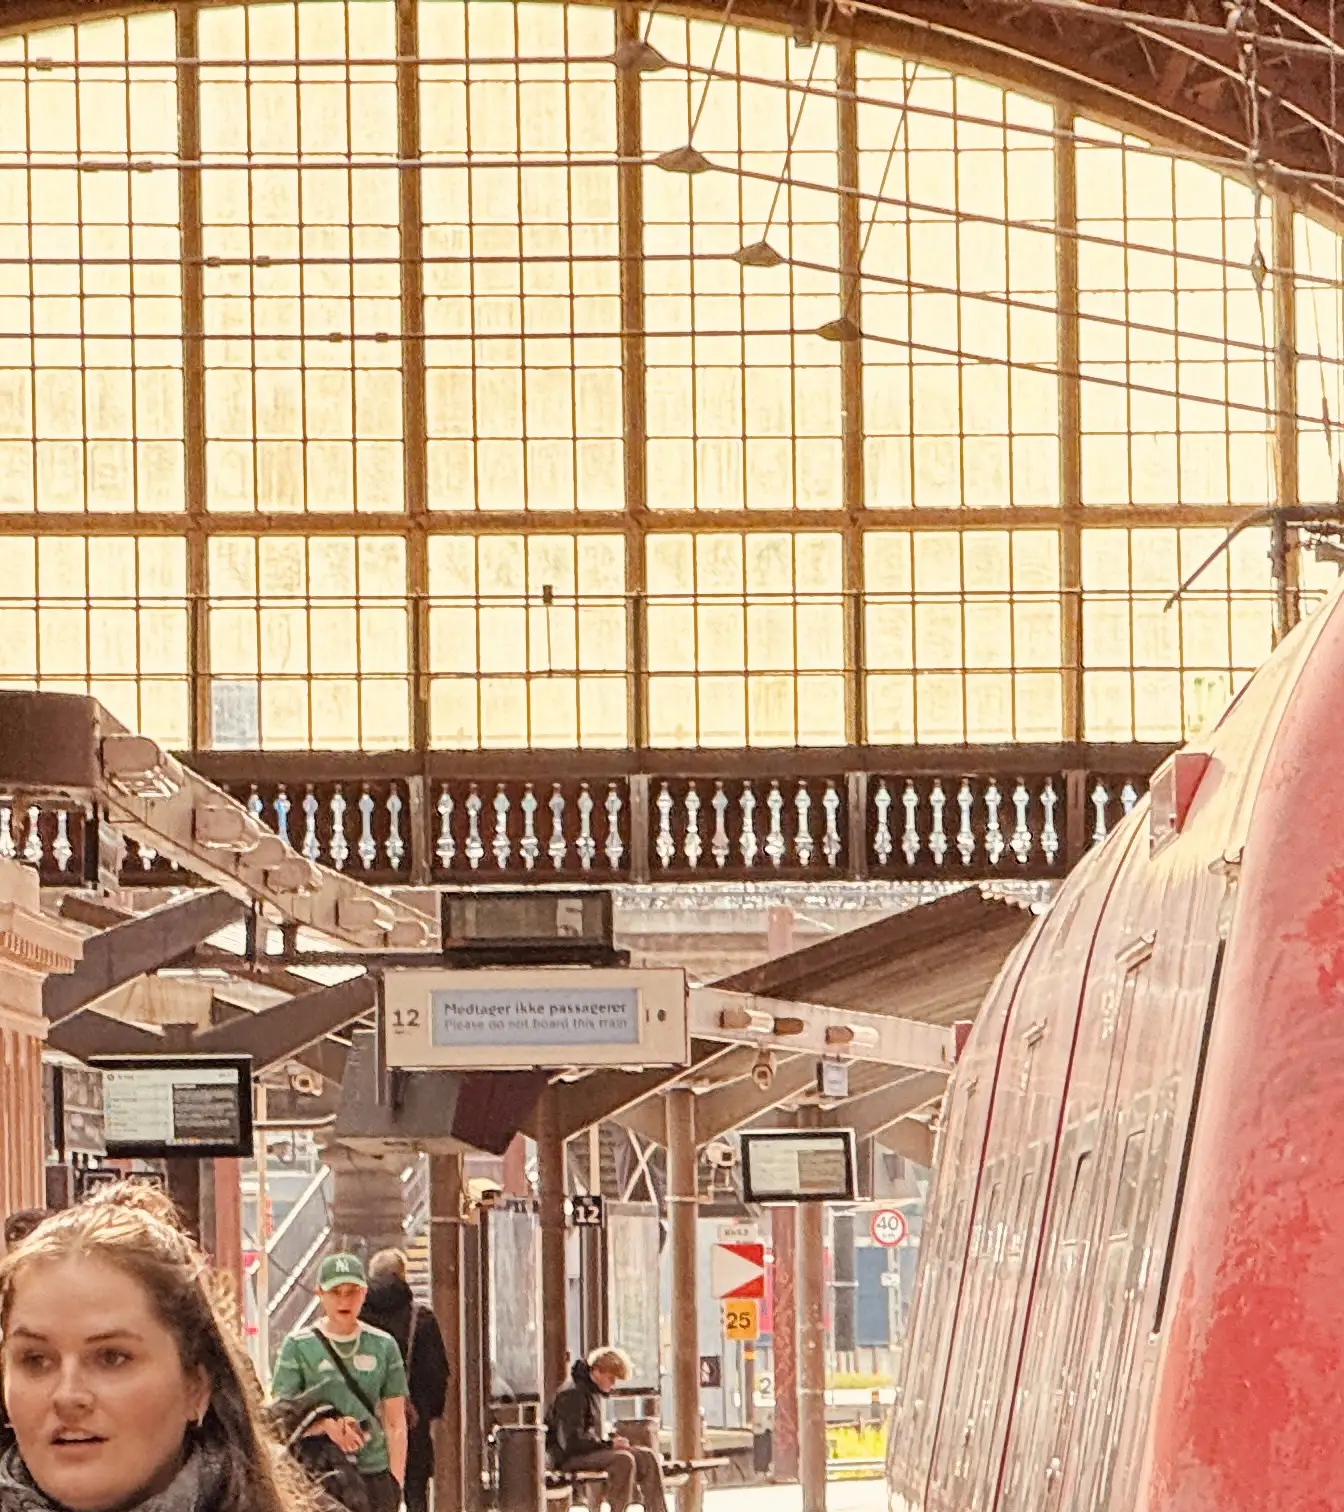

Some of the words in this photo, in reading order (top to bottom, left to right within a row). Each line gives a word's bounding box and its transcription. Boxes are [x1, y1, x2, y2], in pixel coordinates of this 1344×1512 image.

[444, 1001, 510, 1016] Medtager
[515, 1002, 545, 1015] ikke
[550, 1002, 626, 1017] passagerer
[392, 1009, 420, 1026] 12
[444, 1019, 485, 1030] Please
[532, 1018, 569, 1029] board
[573, 1018, 595, 1030] this
[576, 1205, 600, 1223] 12
[876, 1216, 899, 1231] 40
[726, 1311, 751, 1330] 25
